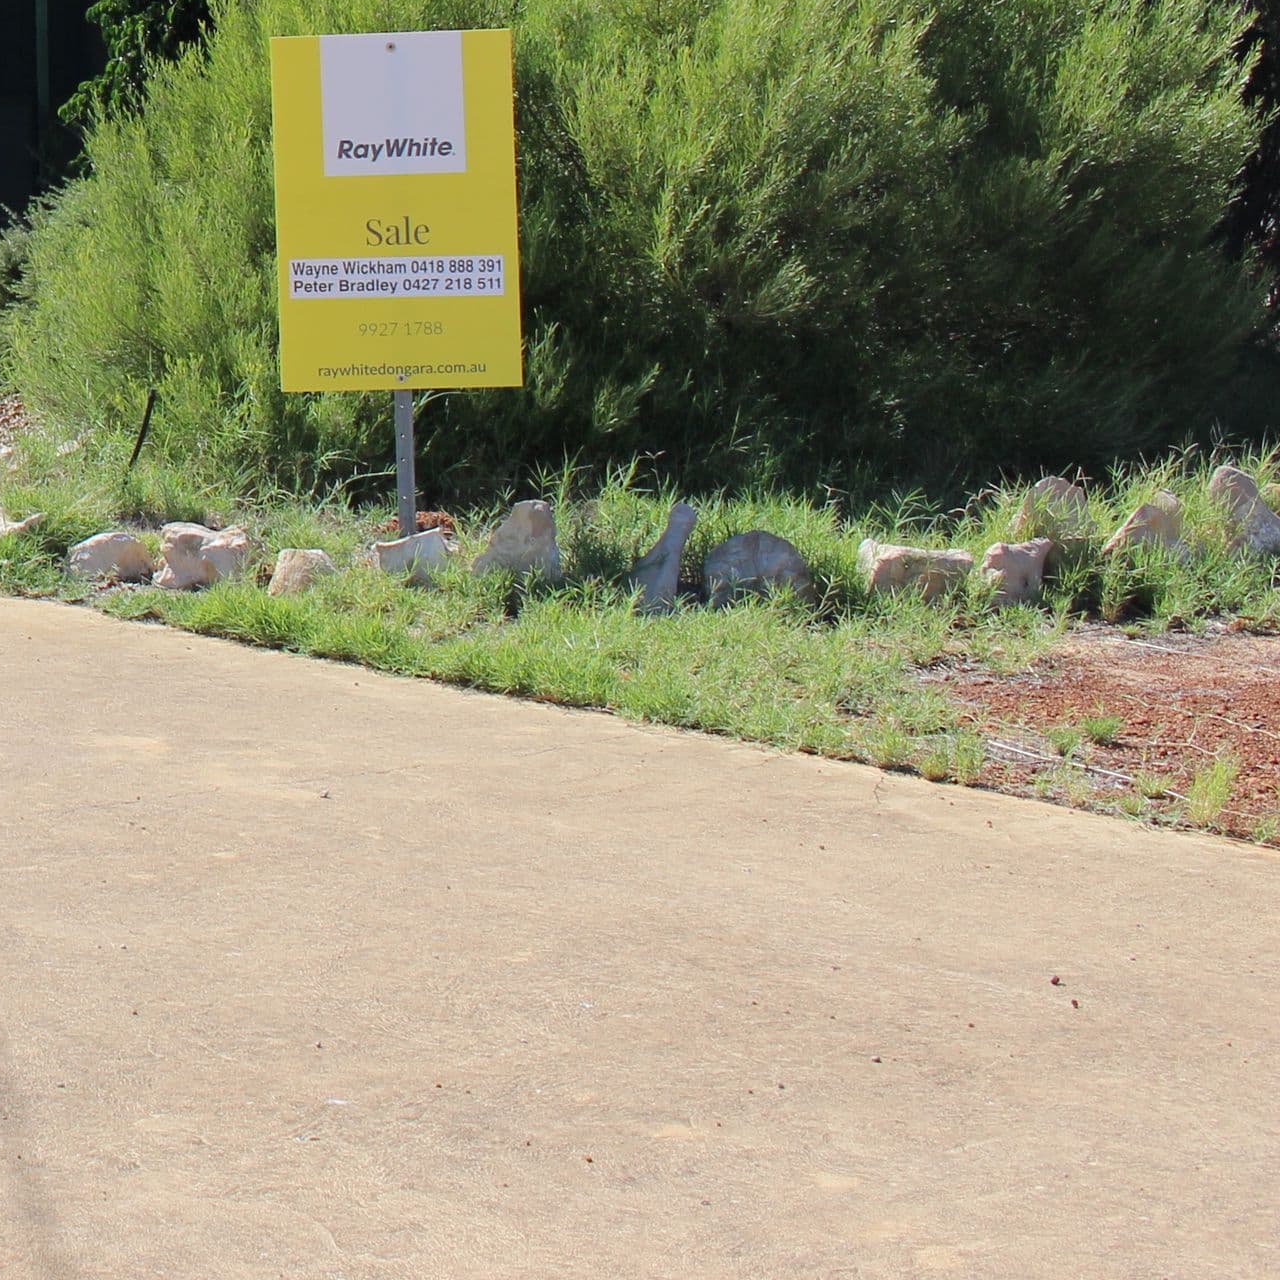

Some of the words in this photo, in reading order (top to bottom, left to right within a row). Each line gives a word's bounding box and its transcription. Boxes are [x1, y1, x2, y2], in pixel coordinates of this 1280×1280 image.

[366, 215, 430, 246] Sale
[291, 261, 338, 279] Wayne
[343, 260, 407, 275] Wickham
[411, 260, 444, 274] 0418
[448, 259, 474, 273] 888
[478, 259, 502, 273] 391
[293, 280, 334, 293] Peter
[339, 278, 398, 294] Bradley
[402, 278, 439, 291] 0427
[445, 277, 473, 290] 218
[477, 277, 501, 290] 511
[358, 322, 399, 337] 9927
[317, 362, 487, 379] raywhitedongara.com.au
